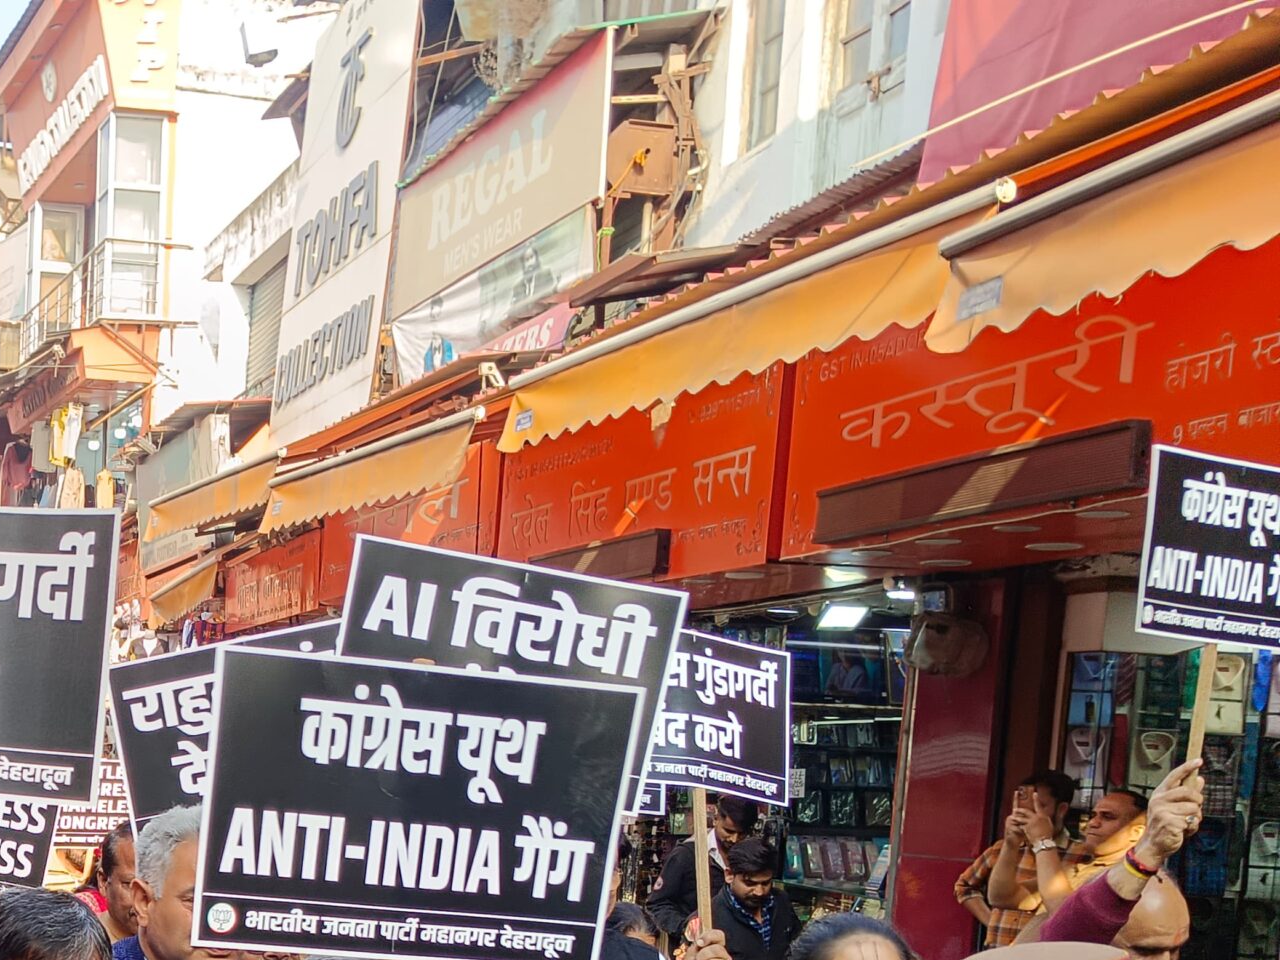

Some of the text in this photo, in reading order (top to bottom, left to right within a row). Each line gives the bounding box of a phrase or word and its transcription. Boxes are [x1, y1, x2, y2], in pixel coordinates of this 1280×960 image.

[427, 108, 554, 251] REGAL
[294, 160, 378, 297] TOHFA
[480, 208, 523, 251] WEAR
[274, 294, 376, 411] COLLECTION
[839, 315, 1155, 449] कस्तूरी
[569, 479, 613, 539] सिंह
[692, 445, 757, 507] सन्स
[1180, 471, 1249, 530] कांग्रेस
[1146, 546, 1265, 604] ANTI-INDIA
[362, 574, 439, 641] AI
[451, 576, 659, 680] विरोधी
[121, 673, 215, 737] राहु
[692, 647, 778, 708] गुंडागर्दी
[299, 684, 547, 804] कांग्रेस यूथ
[692, 711, 743, 760] करो
[655, 761, 687, 775] जनता
[709, 767, 746, 787] महानगर
[745, 773, 778, 797] देहरादून
[219, 806, 595, 903] ANTI-INDIA गैंग
[245, 906, 576, 959] भारतीय जनता पार्टी महानगर देहरादून
